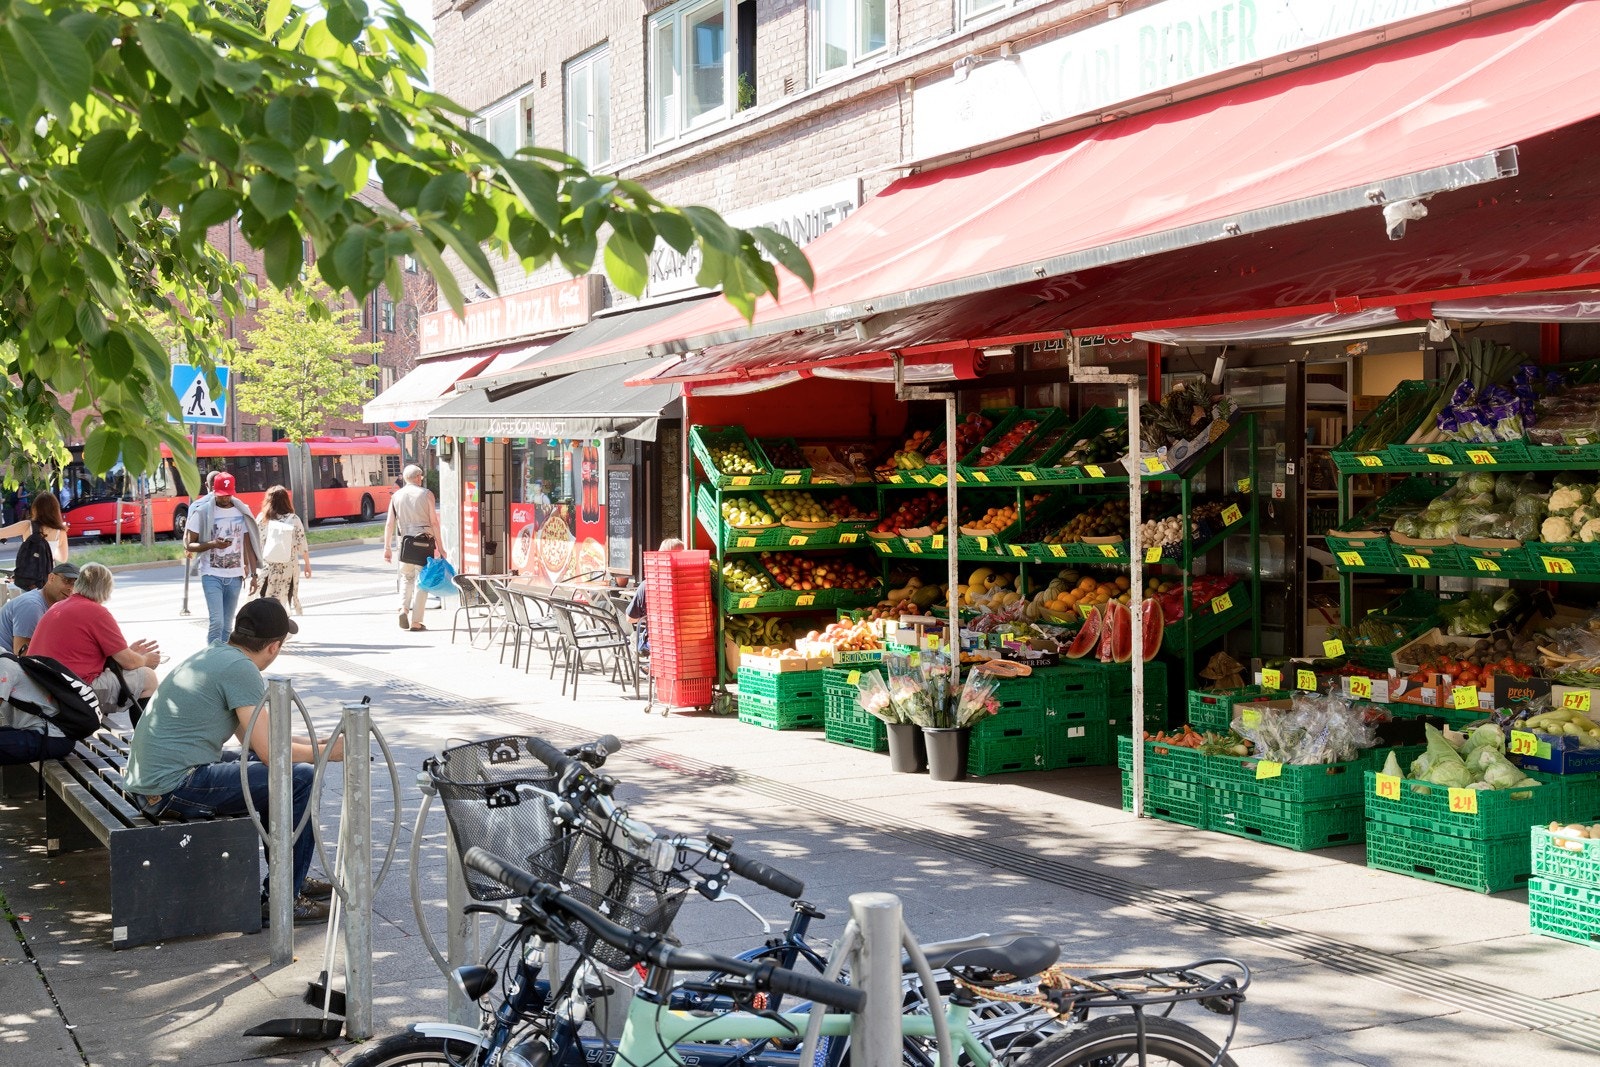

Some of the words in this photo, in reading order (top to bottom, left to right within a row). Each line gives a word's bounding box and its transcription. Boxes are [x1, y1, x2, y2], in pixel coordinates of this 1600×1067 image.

[1058, 44, 1121, 114] CARL
[1139, 0, 1258, 91] BERNER
[505, 296, 553, 337] PIZZA
[1351, 681, 1367, 696] 24
[1507, 687, 1535, 700] presty
[1513, 738, 1531, 754] 24
[1381, 781, 1393, 795] 19
[1453, 796, 1472, 810] 24
